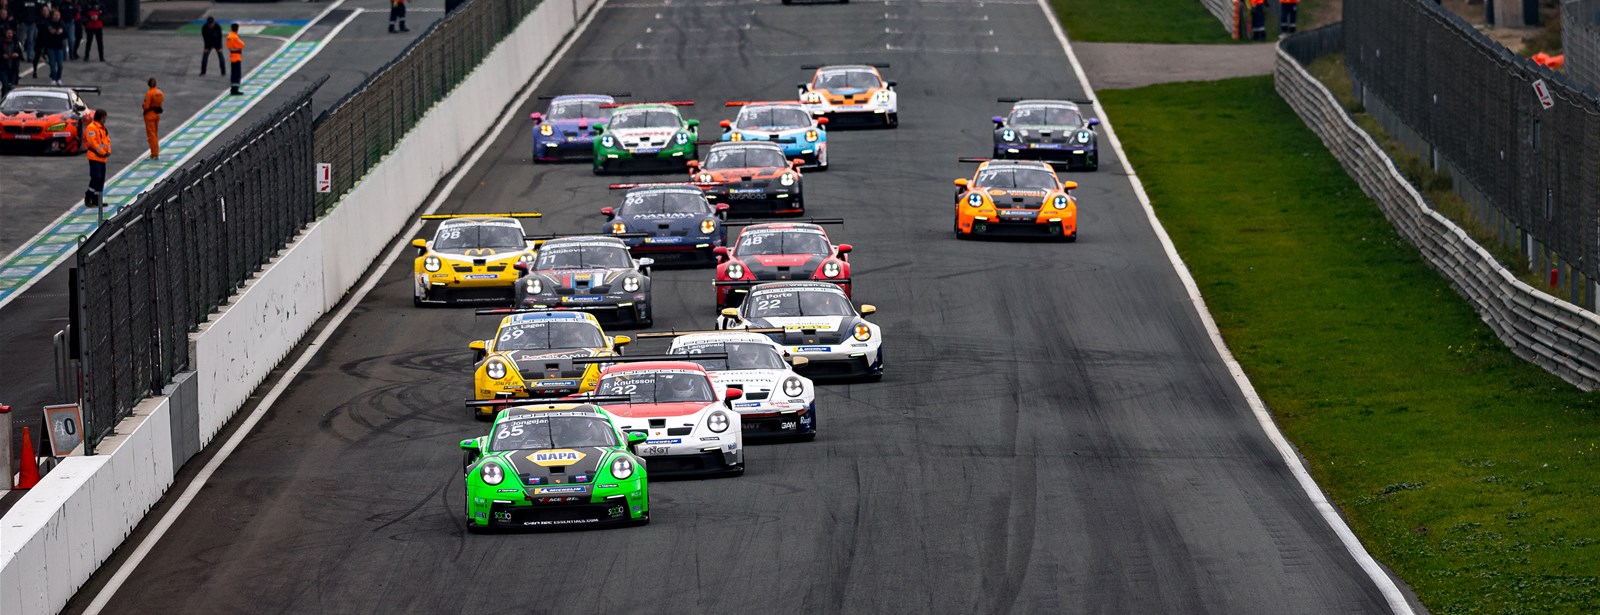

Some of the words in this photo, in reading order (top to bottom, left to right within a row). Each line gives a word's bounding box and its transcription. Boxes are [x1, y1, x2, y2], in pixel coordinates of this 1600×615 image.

[1016, 109, 1031, 118] 23
[322, 165, 329, 181] 1
[980, 172, 998, 182] 77
[625, 196, 644, 206] 96
[441, 231, 461, 241] 98
[742, 236, 763, 247] 48
[540, 254, 556, 265] 11
[758, 299, 781, 311] 22
[499, 329, 524, 342] 69
[688, 342, 725, 350] Langeveld
[613, 379, 655, 387] Knutsson
[611, 384, 637, 395] 32
[511, 418, 549, 427] Jongejan
[497, 424, 525, 440] 65
[536, 452, 578, 461] NAPA
